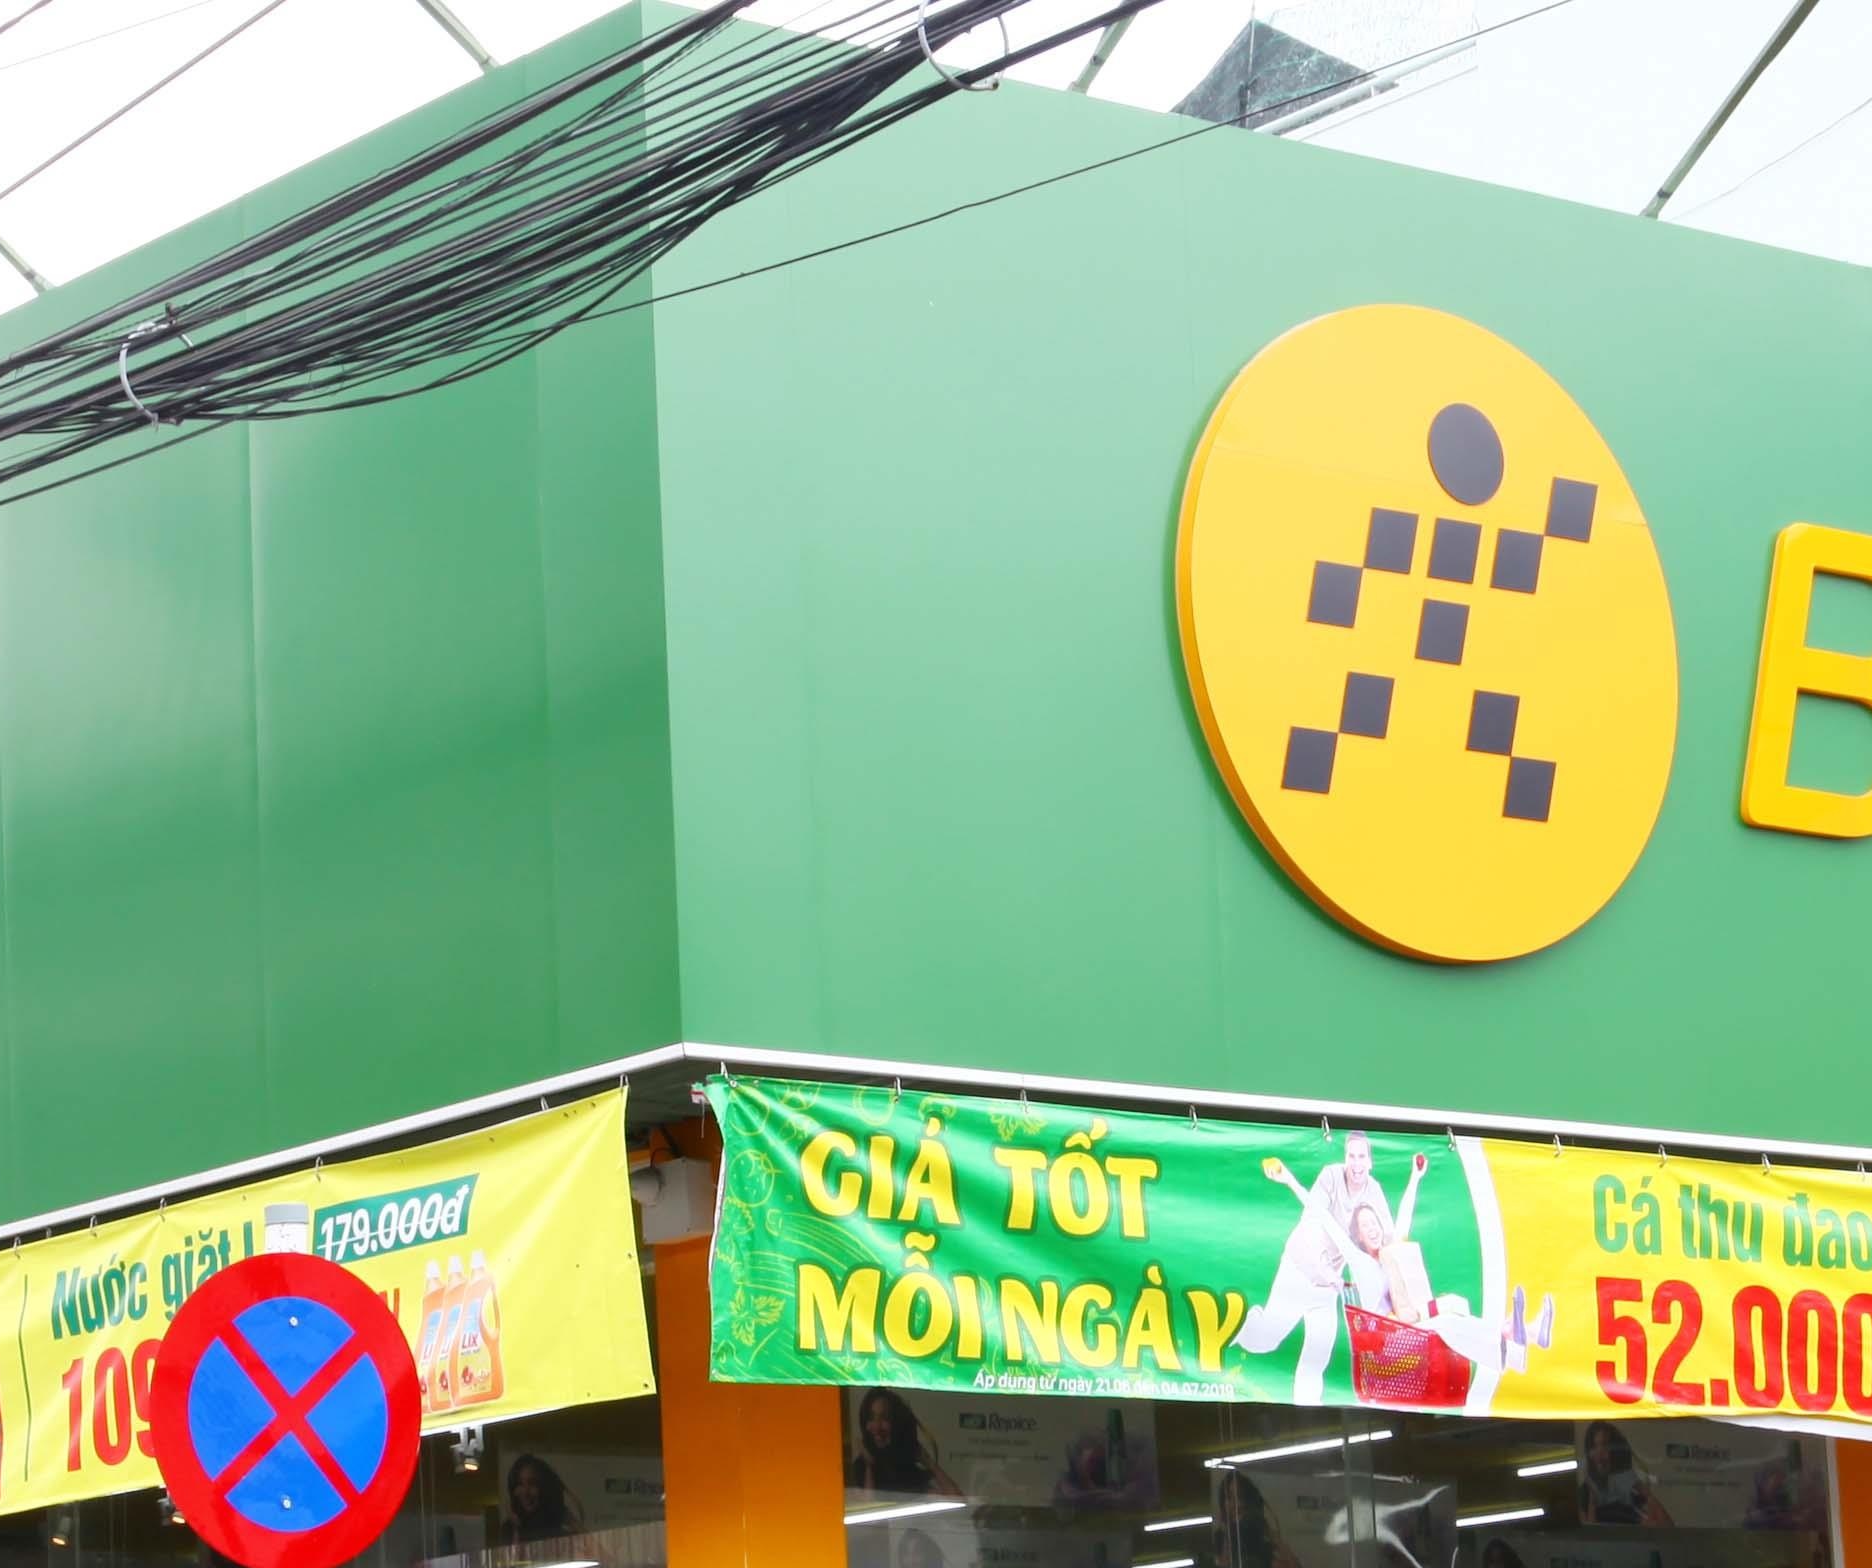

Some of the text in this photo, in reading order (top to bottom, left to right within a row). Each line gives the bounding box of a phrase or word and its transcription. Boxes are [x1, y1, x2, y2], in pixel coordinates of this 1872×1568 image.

[319, 1185, 471, 1263] 179.000đ
[799, 1117, 1158, 1240] GIÁ TỐT
[1593, 1173, 1654, 1256] Cá
[1677, 1182, 1765, 1265] thu
[50, 1250, 149, 1341] Nước
[796, 1231, 1249, 1375] MỖI NGÀY
[973, 1372, 994, 1389] Áp
[999, 1373, 1036, 1394] dụng
[1040, 1373, 1058, 1389] từ
[1058, 1375, 1094, 1395] ngày
